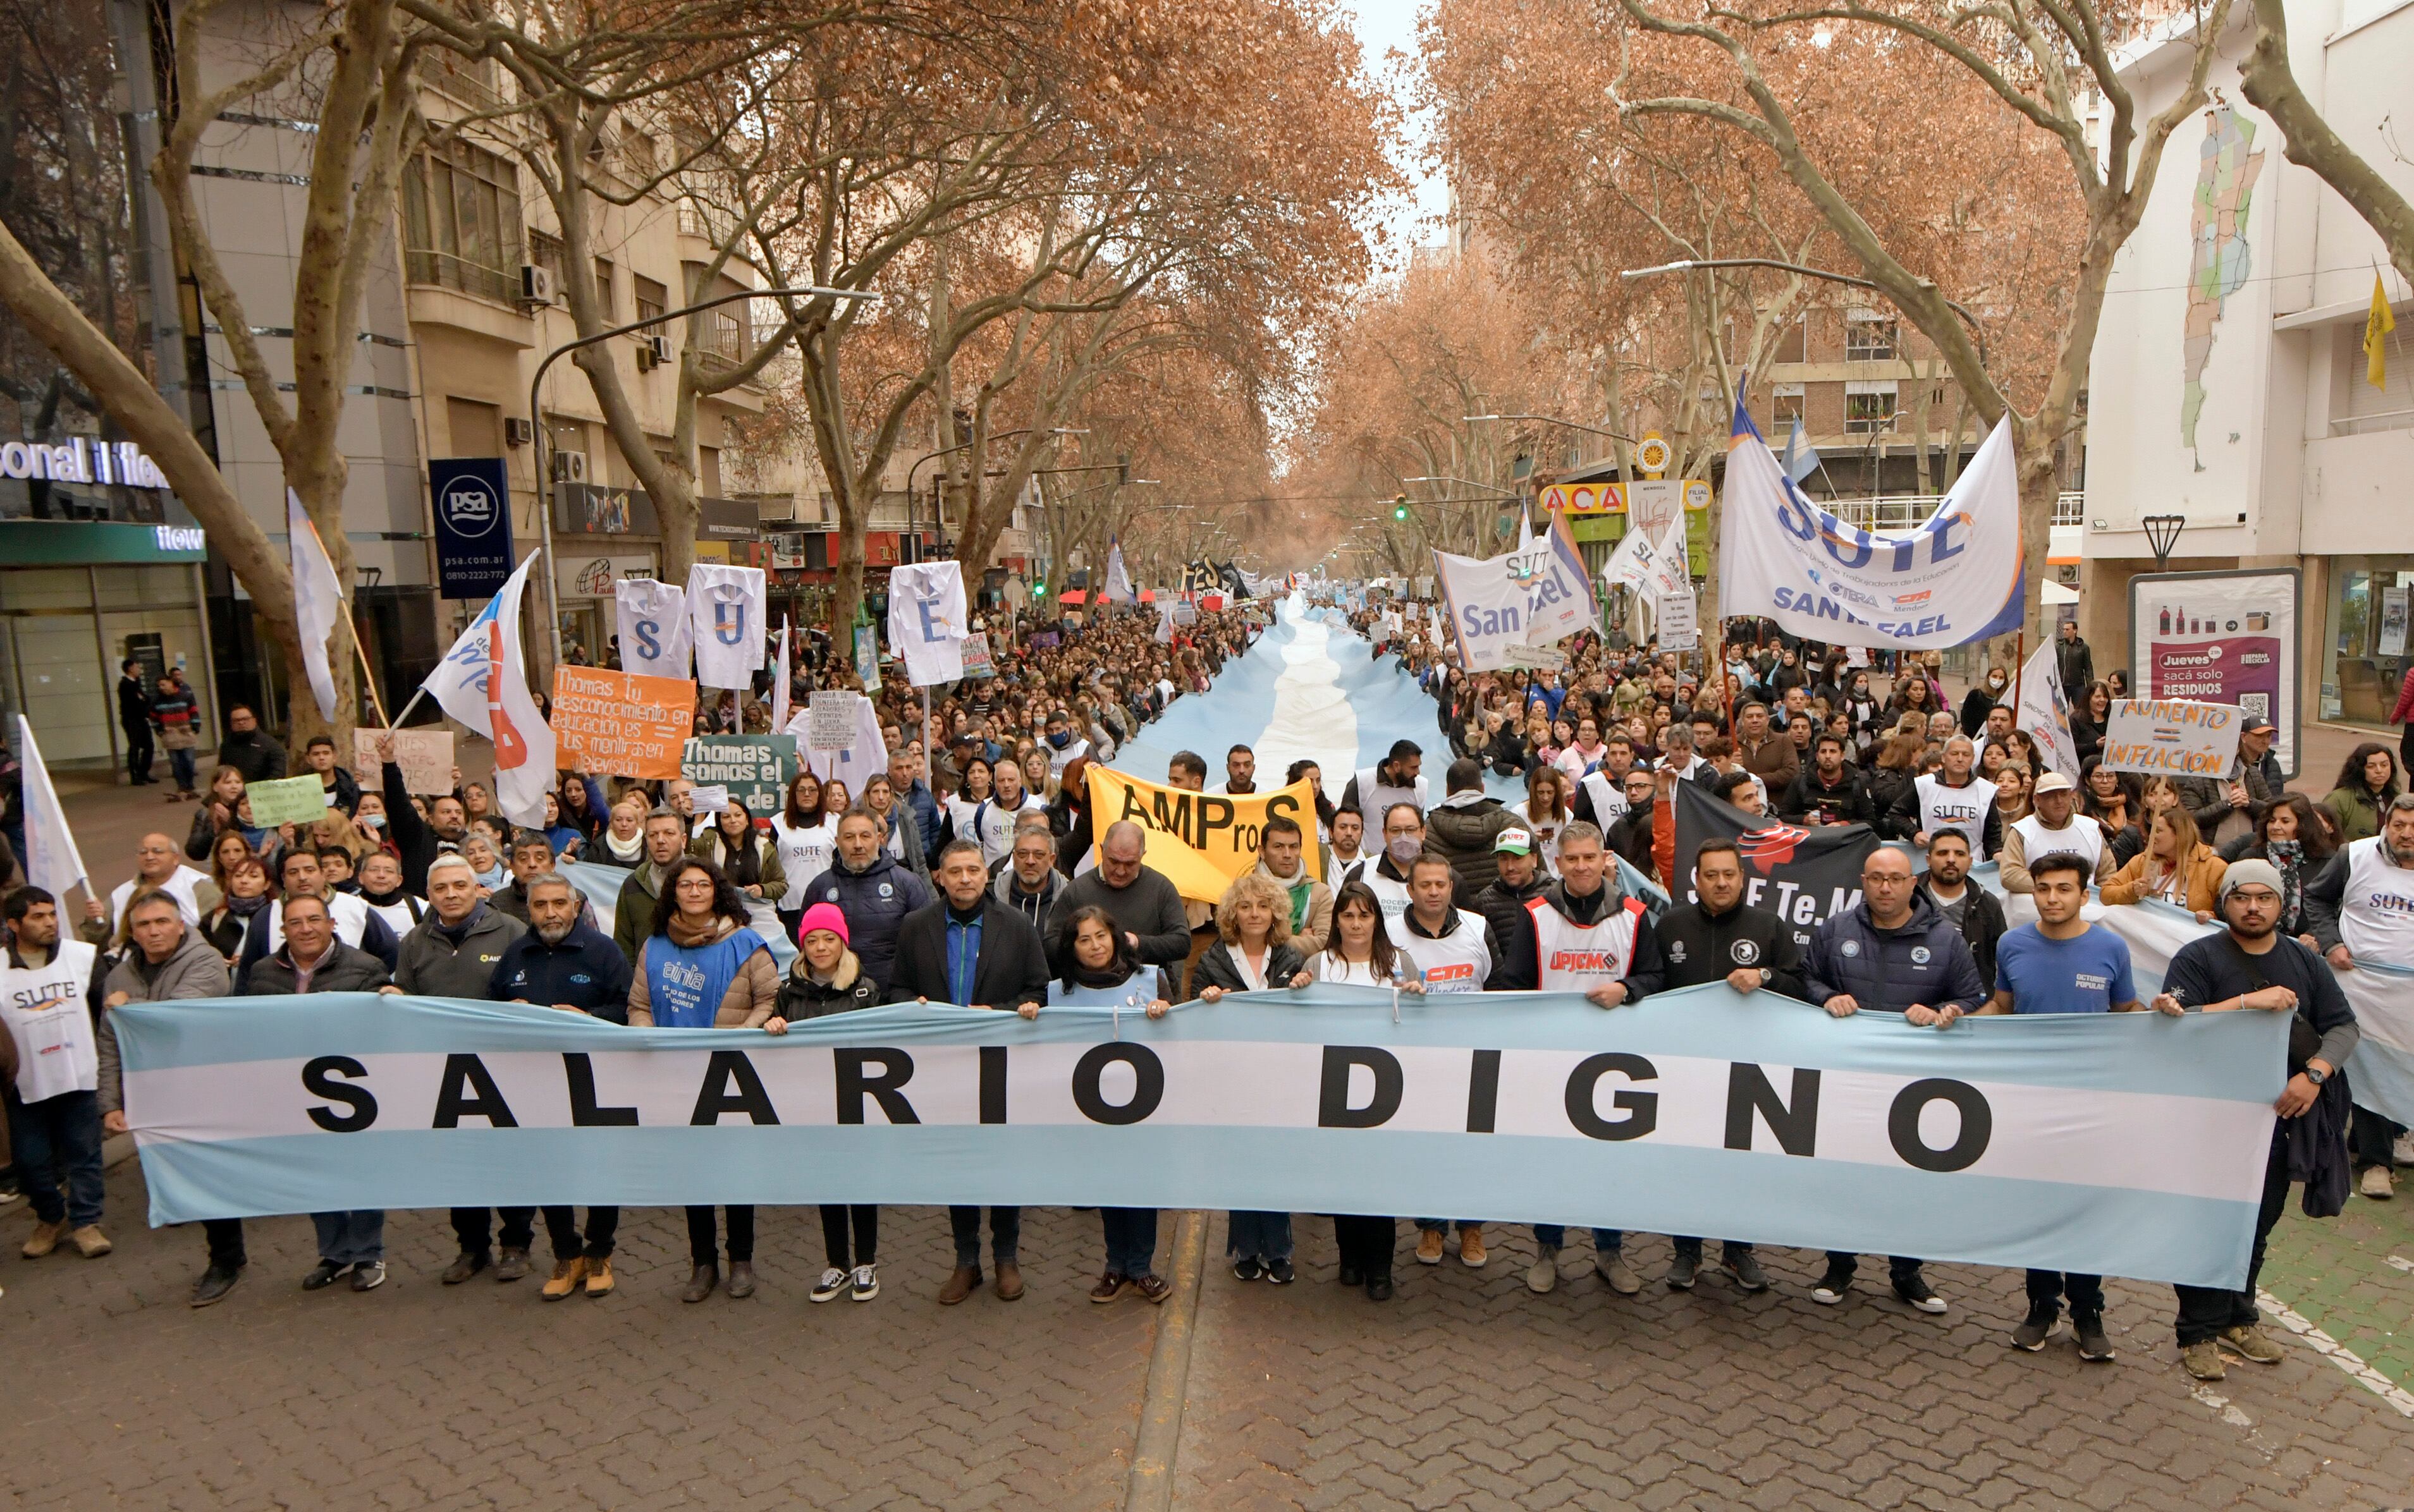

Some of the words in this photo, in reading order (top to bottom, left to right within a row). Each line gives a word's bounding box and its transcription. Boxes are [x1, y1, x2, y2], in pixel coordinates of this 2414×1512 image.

[0, 437, 92, 484] onal
[450, 491, 489, 512] psa
[1547, 487, 1621, 511] ACA
[156, 526, 205, 550] flow
[445, 556, 505, 566] psa.com.ar
[1506, 551, 1549, 580] SUT
[1180, 556, 1220, 592] FES
[1901, 578, 1912, 587] de
[1774, 587, 1840, 621] SAN
[1829, 582, 1880, 608] CTERA
[1896, 589, 1932, 604] CTA
[635, 620, 661, 661] S
[714, 603, 744, 645] U
[917, 599, 947, 643] E
[1462, 604, 1520, 638] San
[962, 652, 991, 666] LARIOS
[2163, 655, 2210, 666] Jueves
[556, 668, 614, 697] Thomas
[2164, 670, 2193, 681] sacá
[2196, 668, 2223, 680] solo
[2163, 683, 2222, 696] RESIDUOS
[552, 691, 668, 722] desconocimiento
[672, 709, 689, 726] en
[2023, 700, 2053, 726] SINDICATO
[2120, 698, 2231, 729] AUMENTO
[550, 713, 620, 736] educación
[625, 722, 642, 738] es
[561, 729, 584, 750] tus
[684, 736, 771, 763] Thomas
[681, 764, 756, 782] somos
[761, 756, 783, 783] el
[1050, 762, 1067, 771] SUT
[745, 784, 775, 810] de
[1609, 803, 1631, 817] SU
[1933, 805, 1977, 820] SUTE
[793, 845, 821, 858] SUTE
[1426, 963, 1474, 982] CTA
[2076, 973, 2107, 984] OCTUBRE
[13, 981, 77, 1009] SUTE
[678, 991, 687, 999] DE
[687, 994, 701, 1003] LOS
[2075, 980, 2105, 991] POPULAR
[302, 1042, 1164, 1132] SALARIO
[1318, 1046, 1992, 1172] DIGNO
